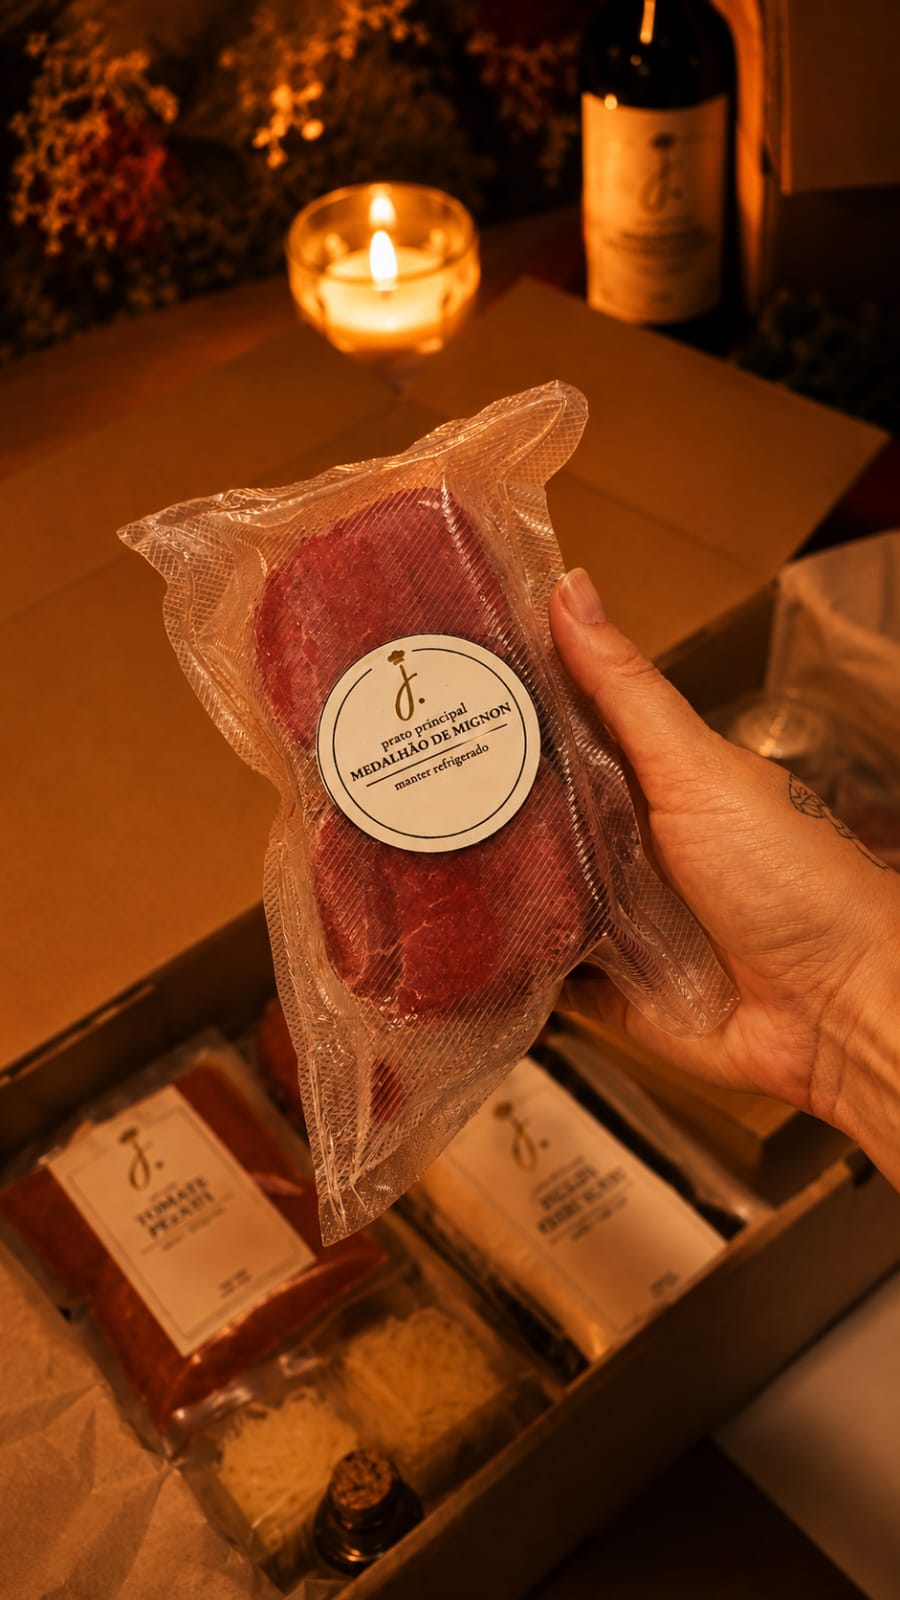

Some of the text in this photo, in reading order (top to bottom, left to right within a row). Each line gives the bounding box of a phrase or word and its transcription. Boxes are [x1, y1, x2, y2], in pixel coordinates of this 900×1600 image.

[350, 702, 512, 782] MEDALHÃO DE MIGNON
[381, 702, 468, 752] prato principal
[394, 743, 489, 791] manter refrigerado
